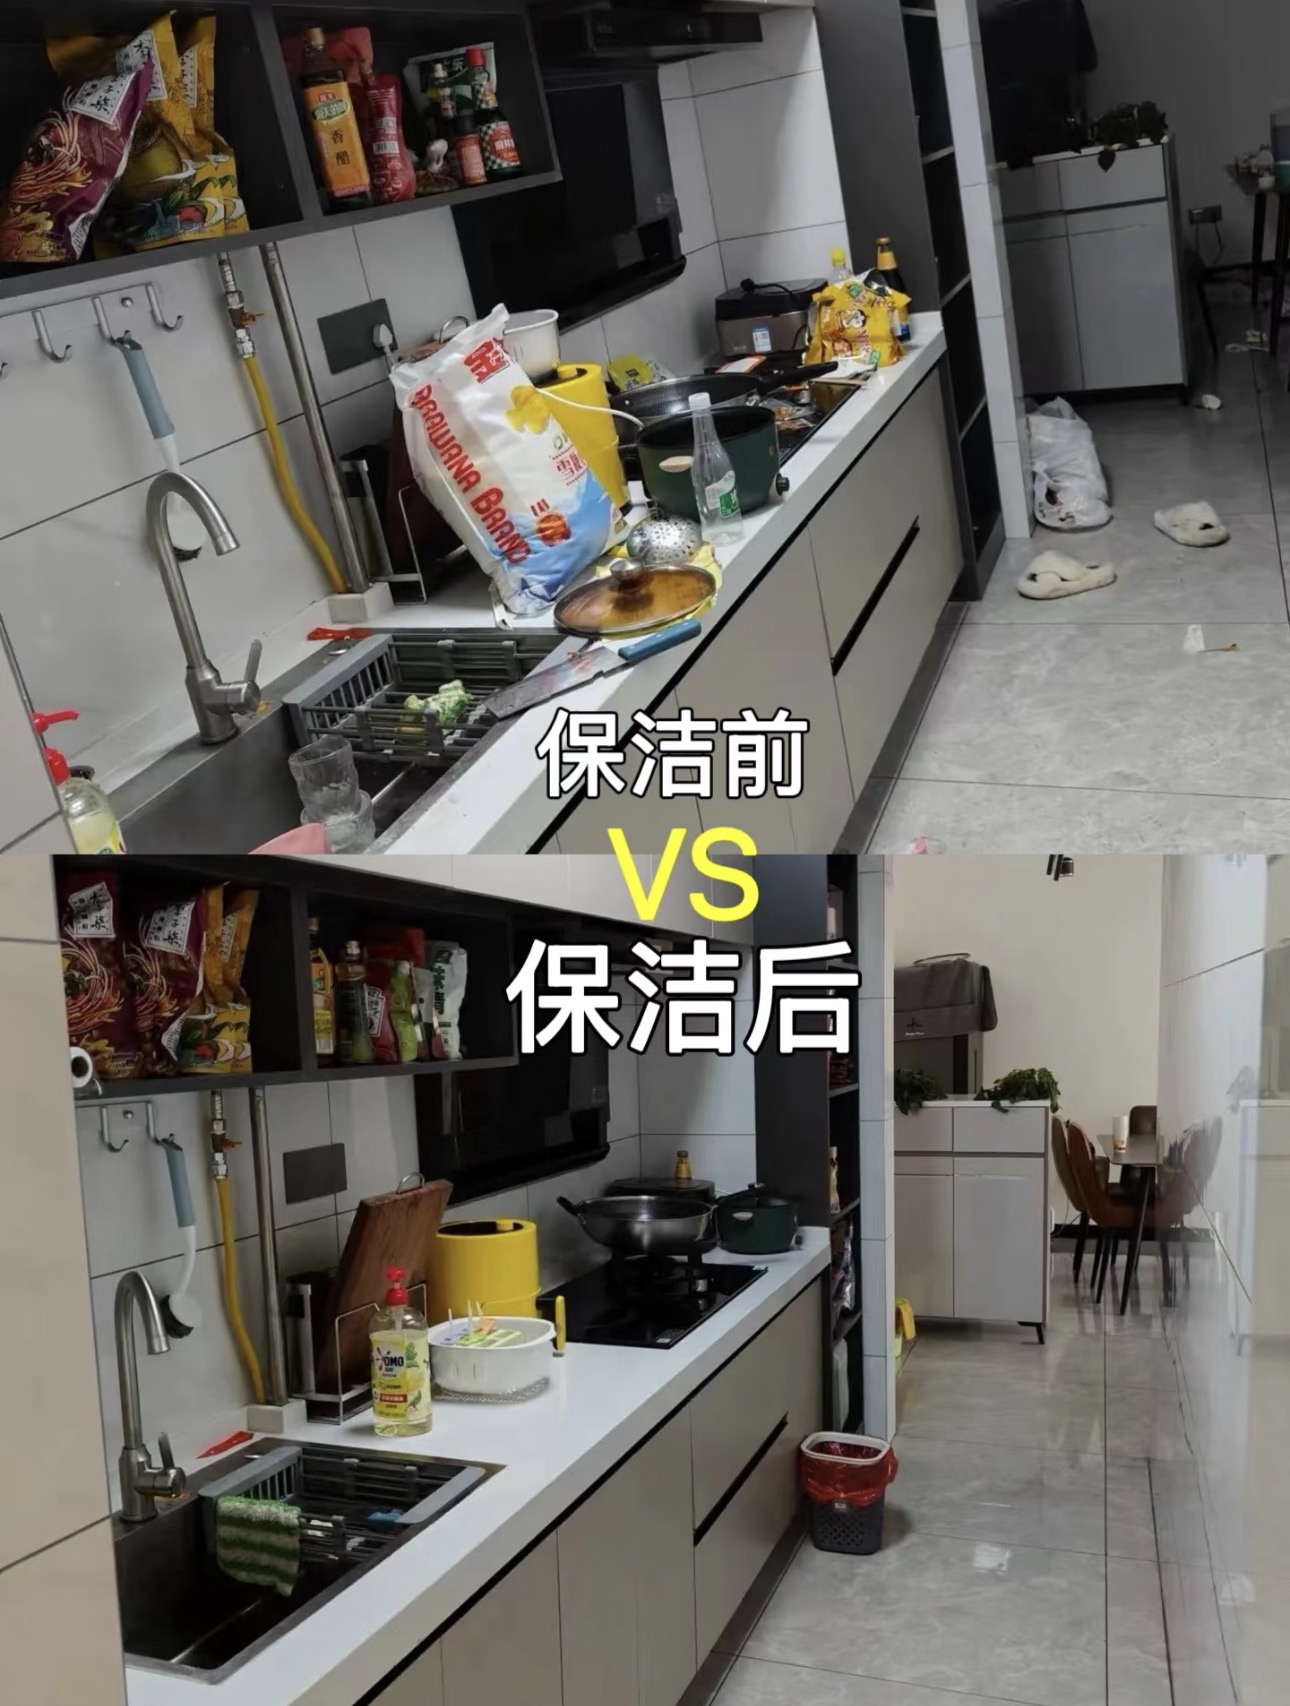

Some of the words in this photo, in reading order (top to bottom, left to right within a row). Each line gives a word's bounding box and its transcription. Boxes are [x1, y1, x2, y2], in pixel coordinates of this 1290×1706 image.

[330, 129, 351, 166] 香醋
[470, 487, 531, 564] BRAND
[383, 1356, 404, 1367] OMO
